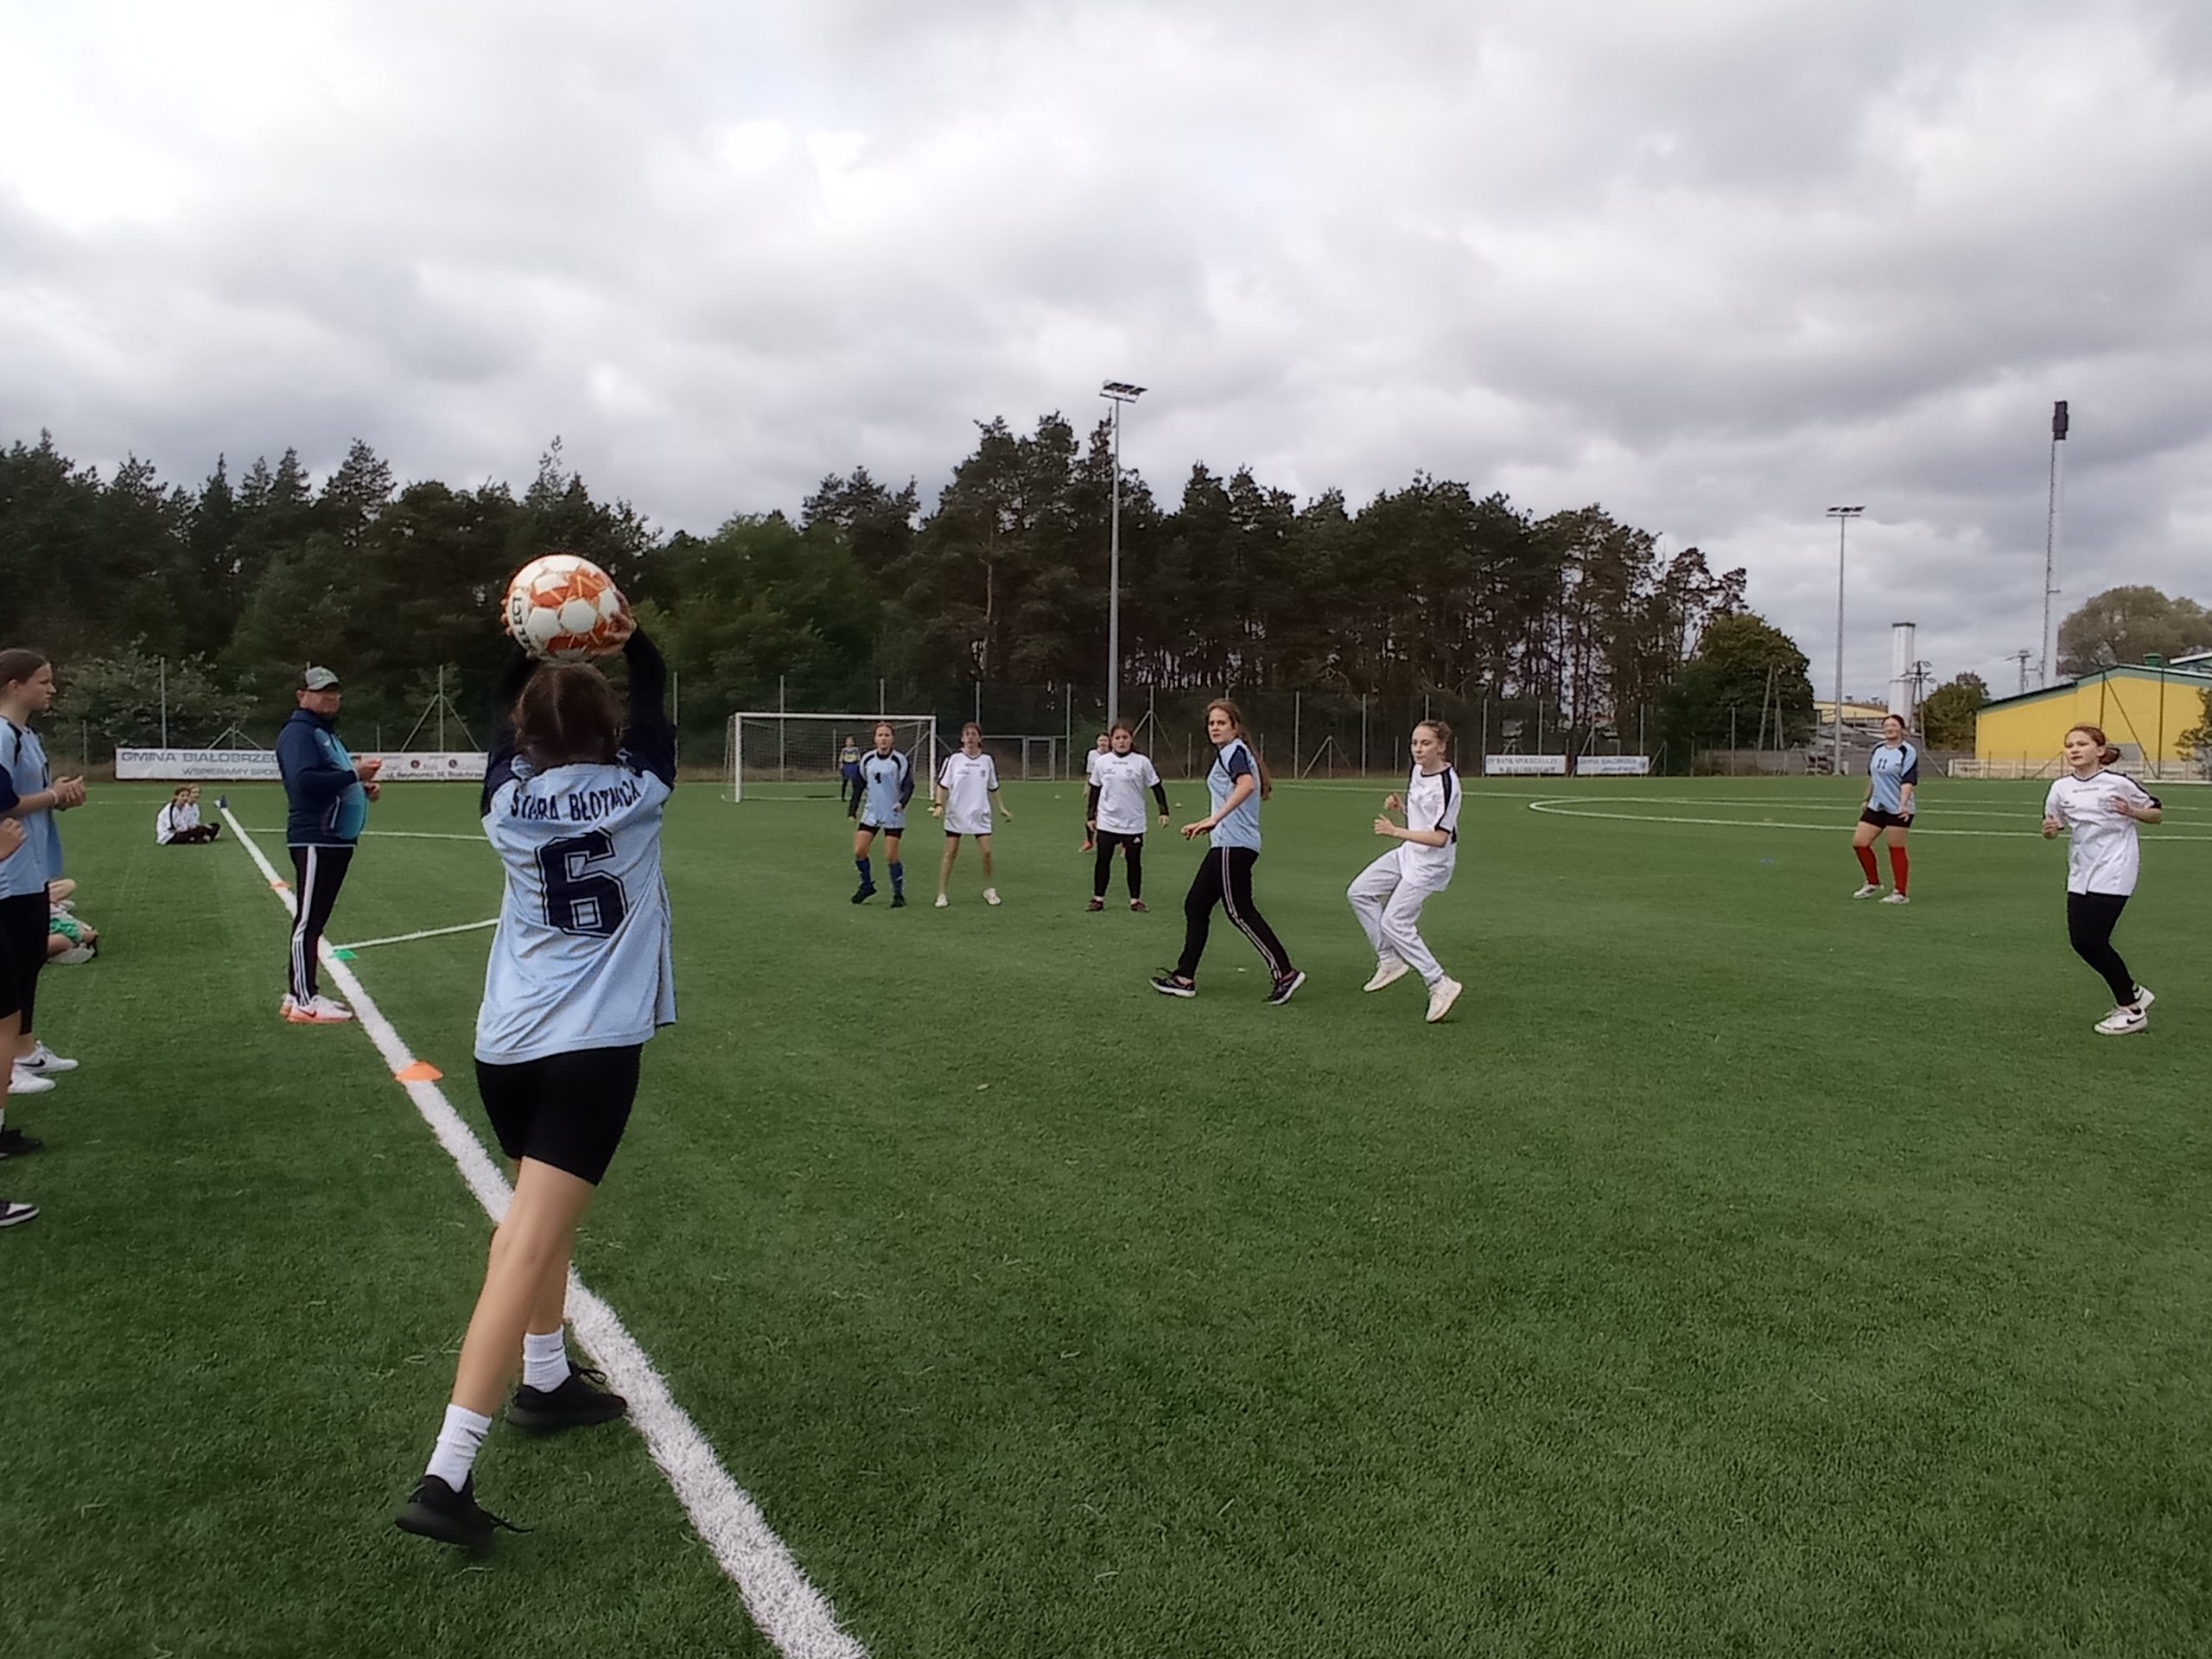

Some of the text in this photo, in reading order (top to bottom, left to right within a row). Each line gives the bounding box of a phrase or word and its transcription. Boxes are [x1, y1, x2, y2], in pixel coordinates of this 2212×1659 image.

[512, 597, 532, 647] ELECT
[121, 752, 176, 762] GMINA
[1876, 758, 1888, 770] 11
[182, 767, 249, 776] WSPIERAMY
[511, 787, 561, 821] STARA
[534, 826, 627, 939] 6
